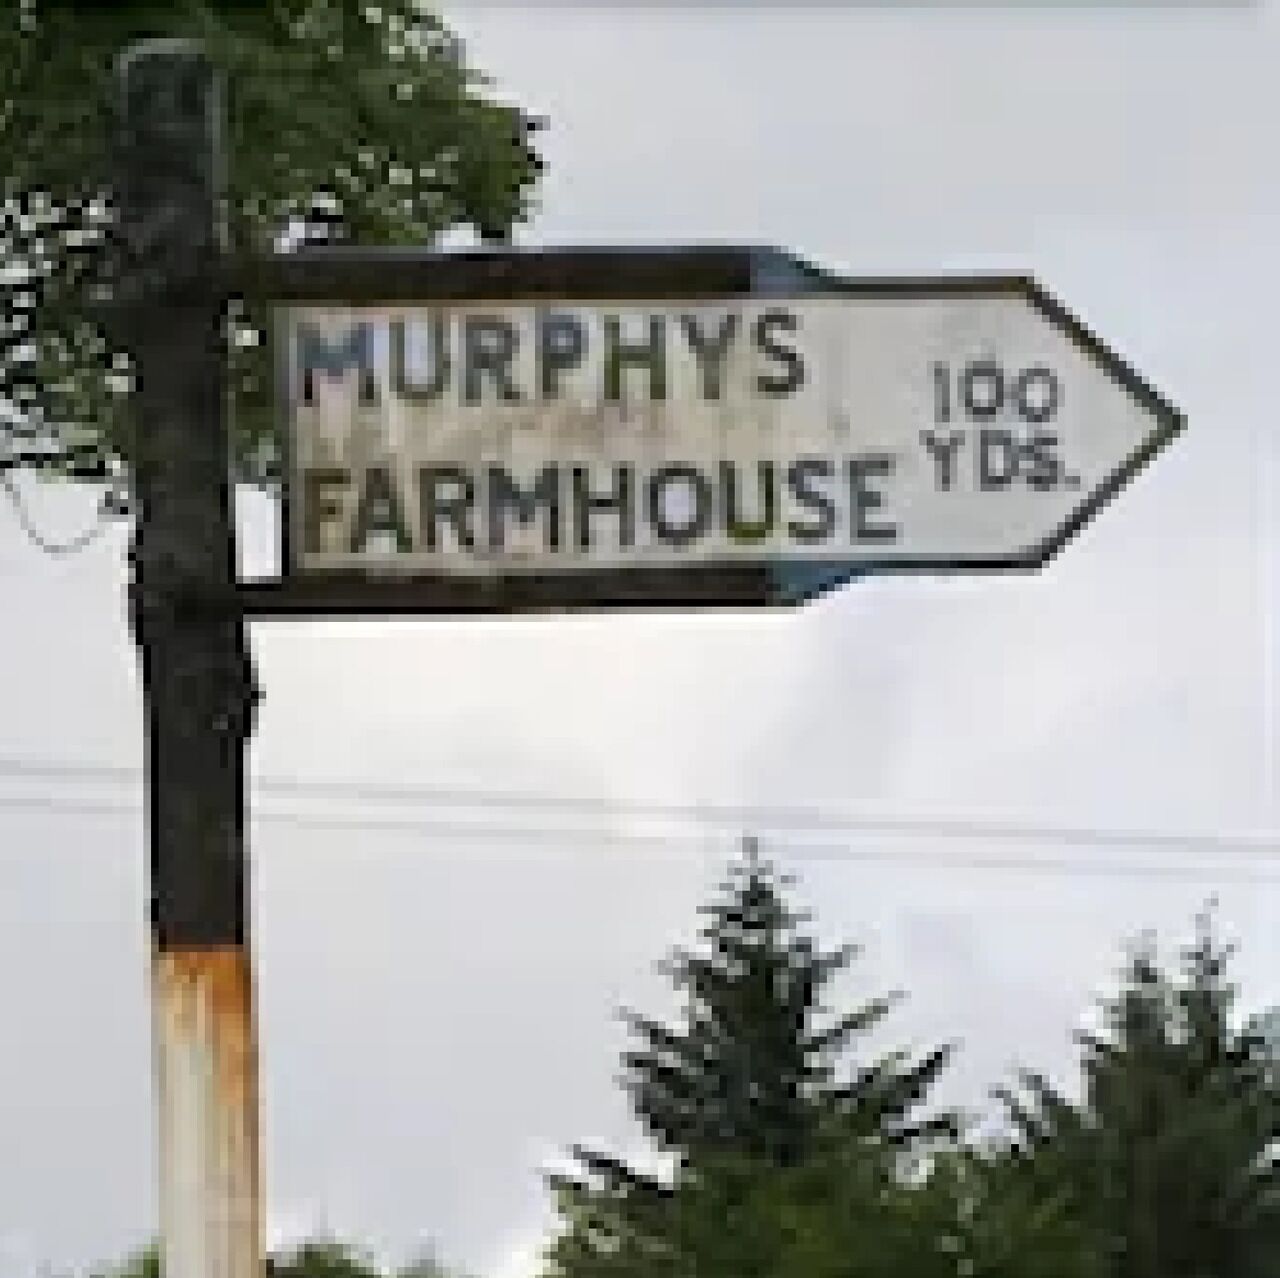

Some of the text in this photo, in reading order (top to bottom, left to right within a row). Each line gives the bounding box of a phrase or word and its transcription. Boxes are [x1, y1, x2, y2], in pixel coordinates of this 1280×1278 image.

[298, 309, 806, 406] MURPHYS
[931, 359, 1061, 423] 100
[919, 430, 1080, 492] YDS.
[303, 454, 902, 554] FARMHOUSE
